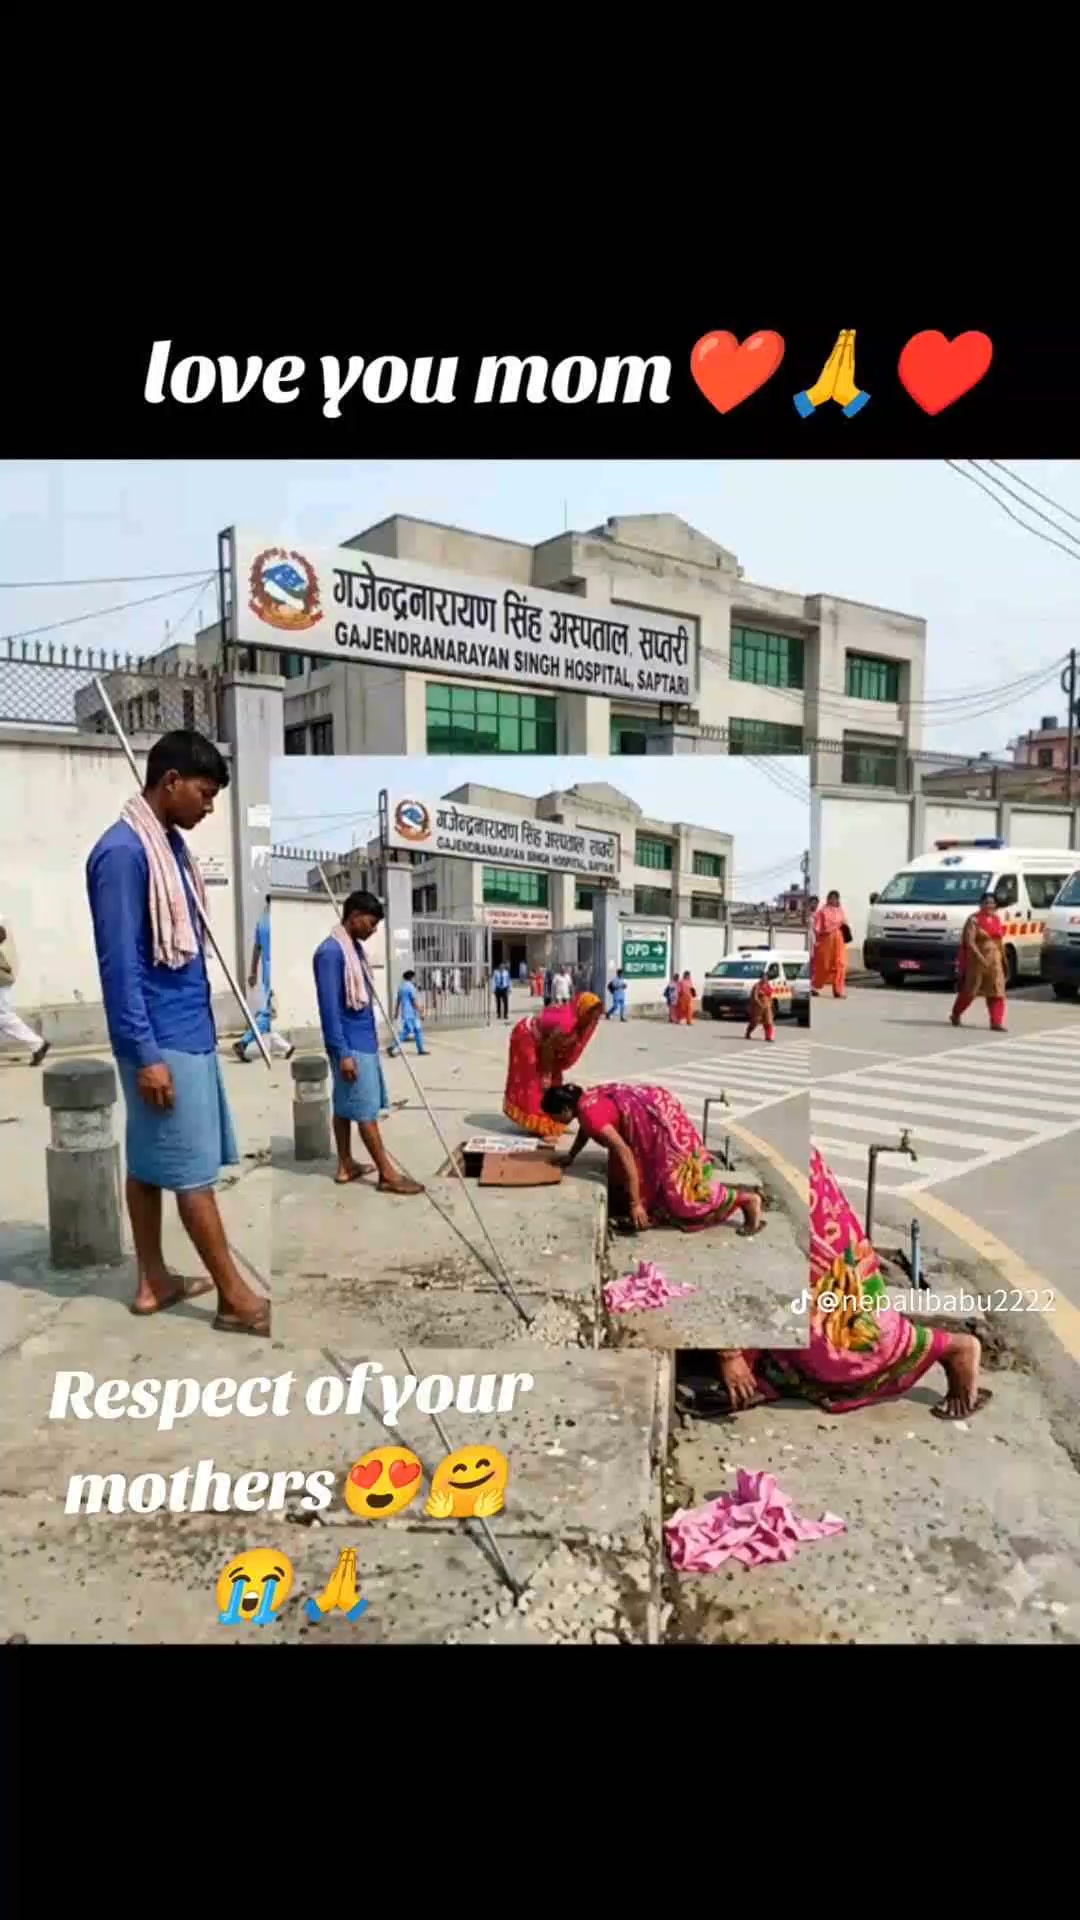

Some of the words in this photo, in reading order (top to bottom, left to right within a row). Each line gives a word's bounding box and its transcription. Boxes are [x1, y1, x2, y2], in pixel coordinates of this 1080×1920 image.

[332, 560, 497, 633] गजेन्द्रनारायण
[503, 589, 543, 643] सिंह
[638, 625, 689, 666] सप्तरी
[335, 621, 509, 670] GAJENDRANARAYAN
[514, 650, 560, 678] SINGH
[564, 657, 634, 692] HOSPITAL,
[637, 669, 689, 696] SAPTARI
